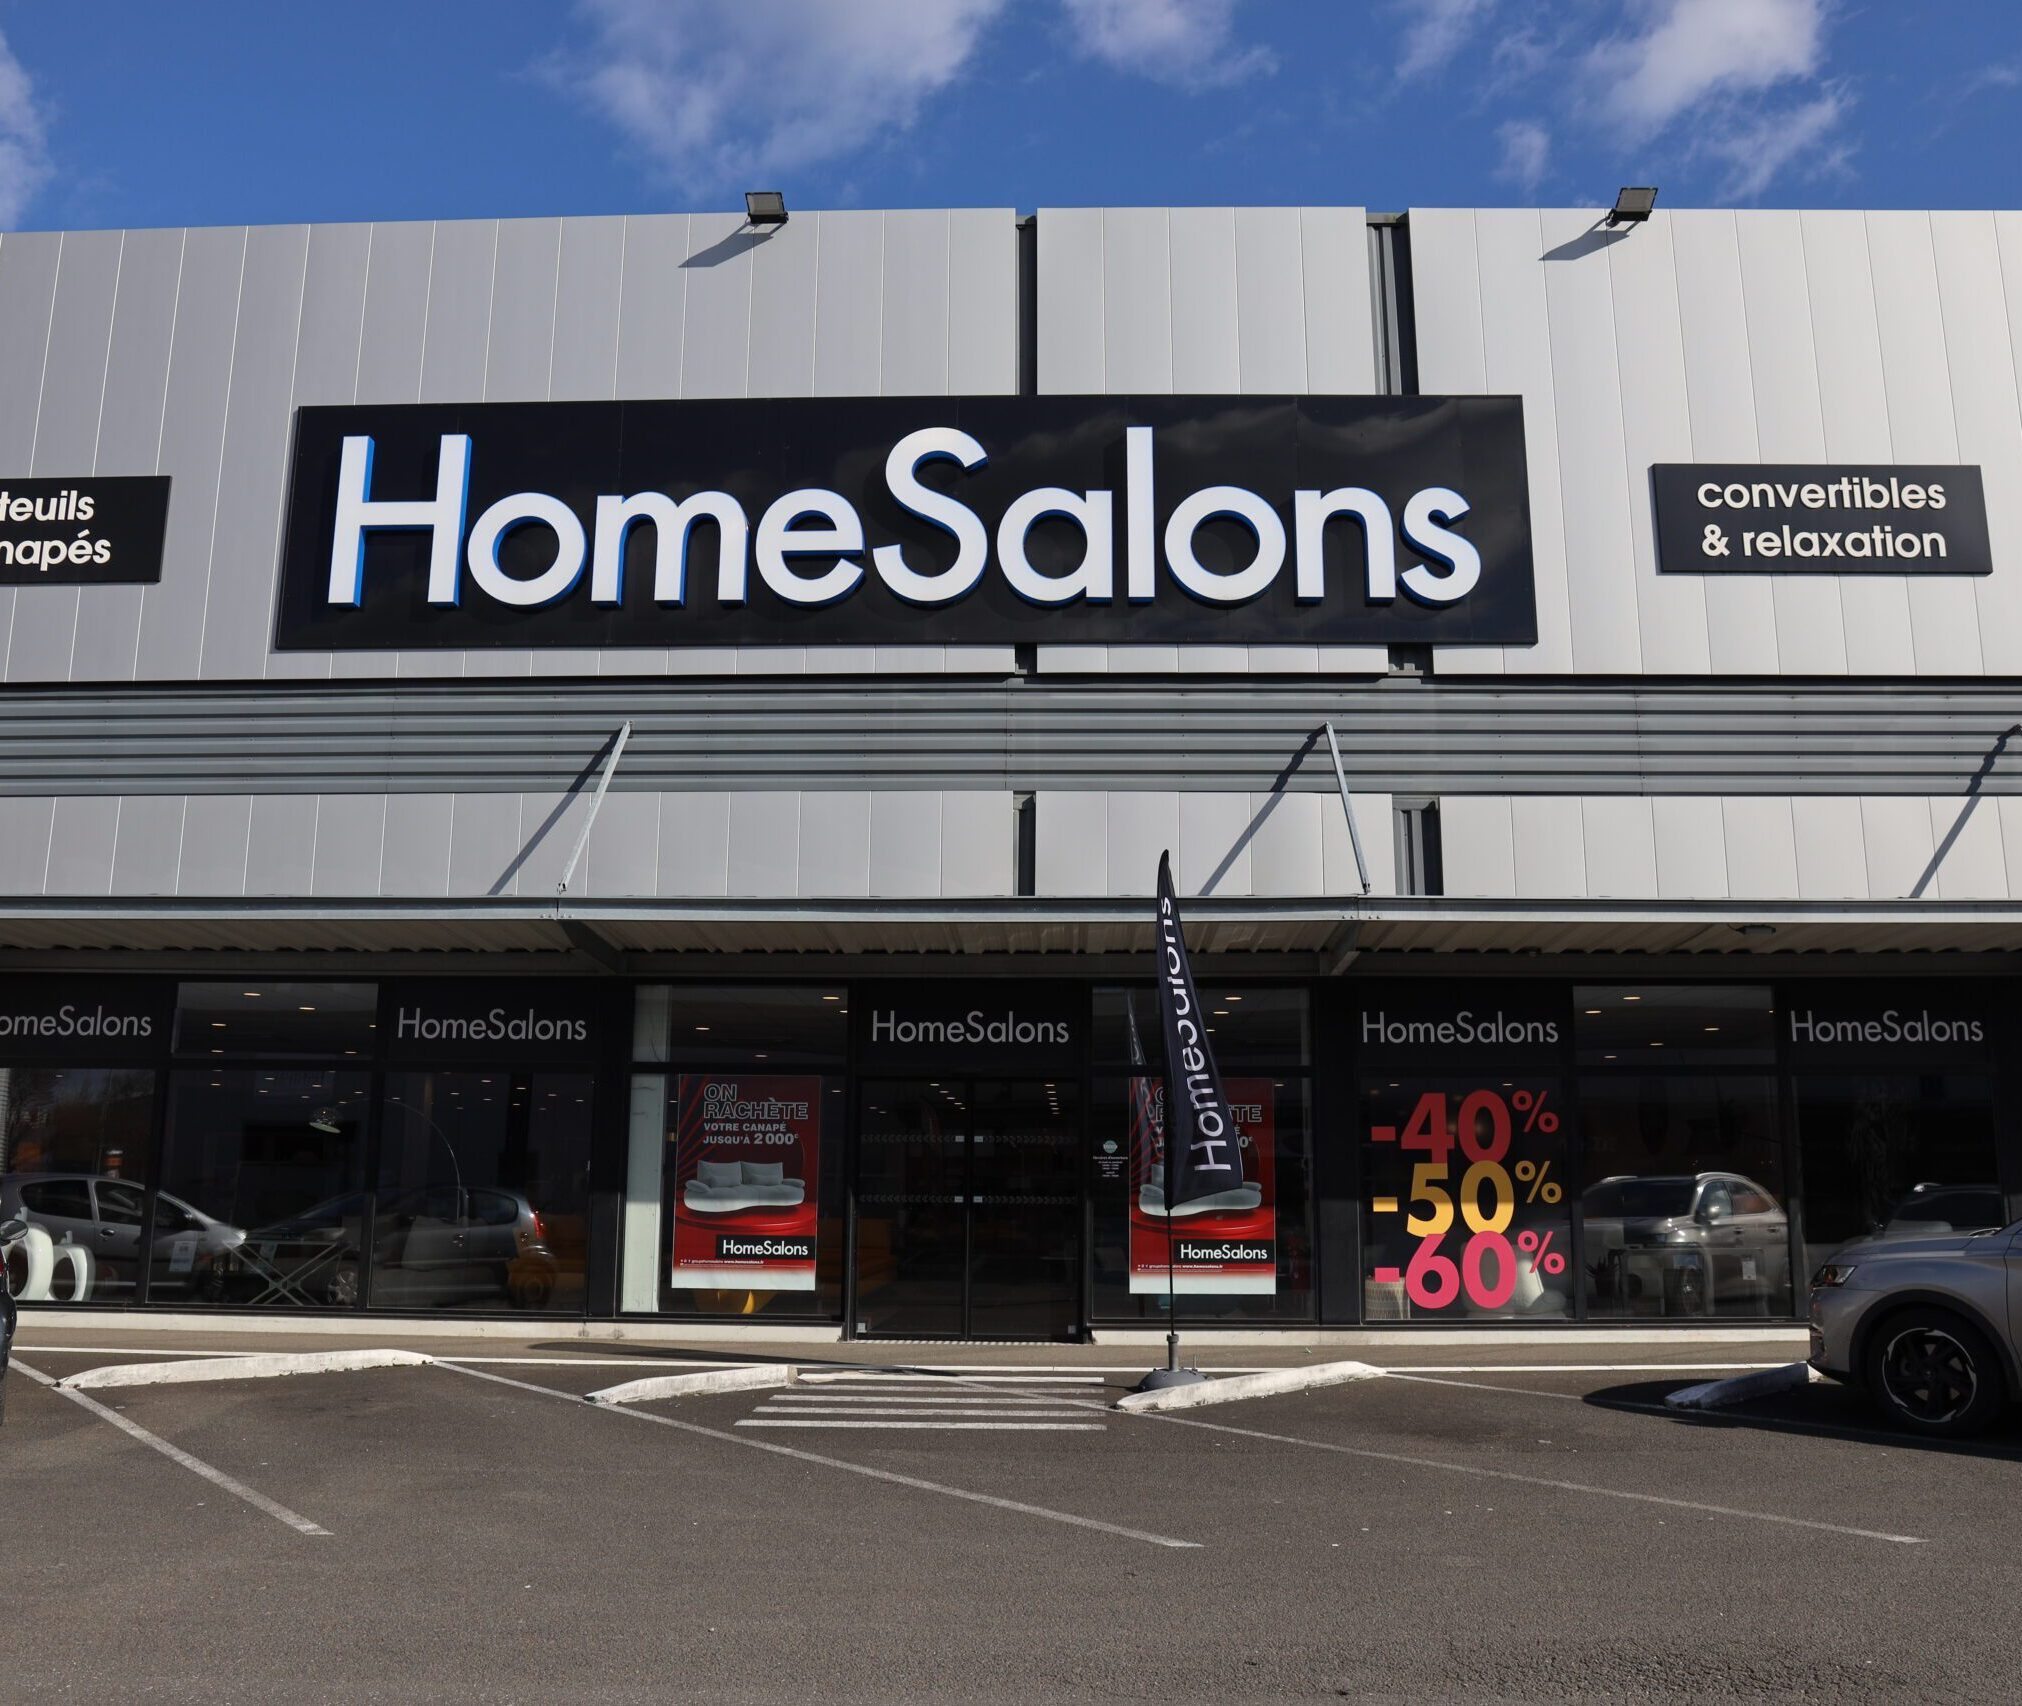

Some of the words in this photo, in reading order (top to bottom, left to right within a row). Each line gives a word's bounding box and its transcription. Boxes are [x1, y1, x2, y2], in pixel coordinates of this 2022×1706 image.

[1697, 477, 1947, 509] convertibles
[328, 426, 1482, 606] HomeSalons
[1702, 524, 1731, 557] &
[1742, 525, 1948, 557] relaxation
[397, 1007, 587, 1041] HomeSalons
[871, 1010, 1070, 1043] HomeSalons
[1361, 1011, 1559, 1044] HomeSalons
[1790, 1010, 1984, 1043] HomeSalons
[703, 1083, 738, 1102] ON
[703, 1097, 809, 1120] RACHÈTE
[702, 1133, 751, 1145] JUSQU'À
[703, 1122, 740, 1132] VOTRE
[742, 1121, 787, 1132] CANAPÉ
[1371, 1089, 1559, 1164] -40%
[1373, 1160, 1562, 1238] -50%
[722, 1239, 809, 1256] HomeSalons
[1180, 1243, 1269, 1260] HomeSalons
[1374, 1230, 1565, 1309] -60%
